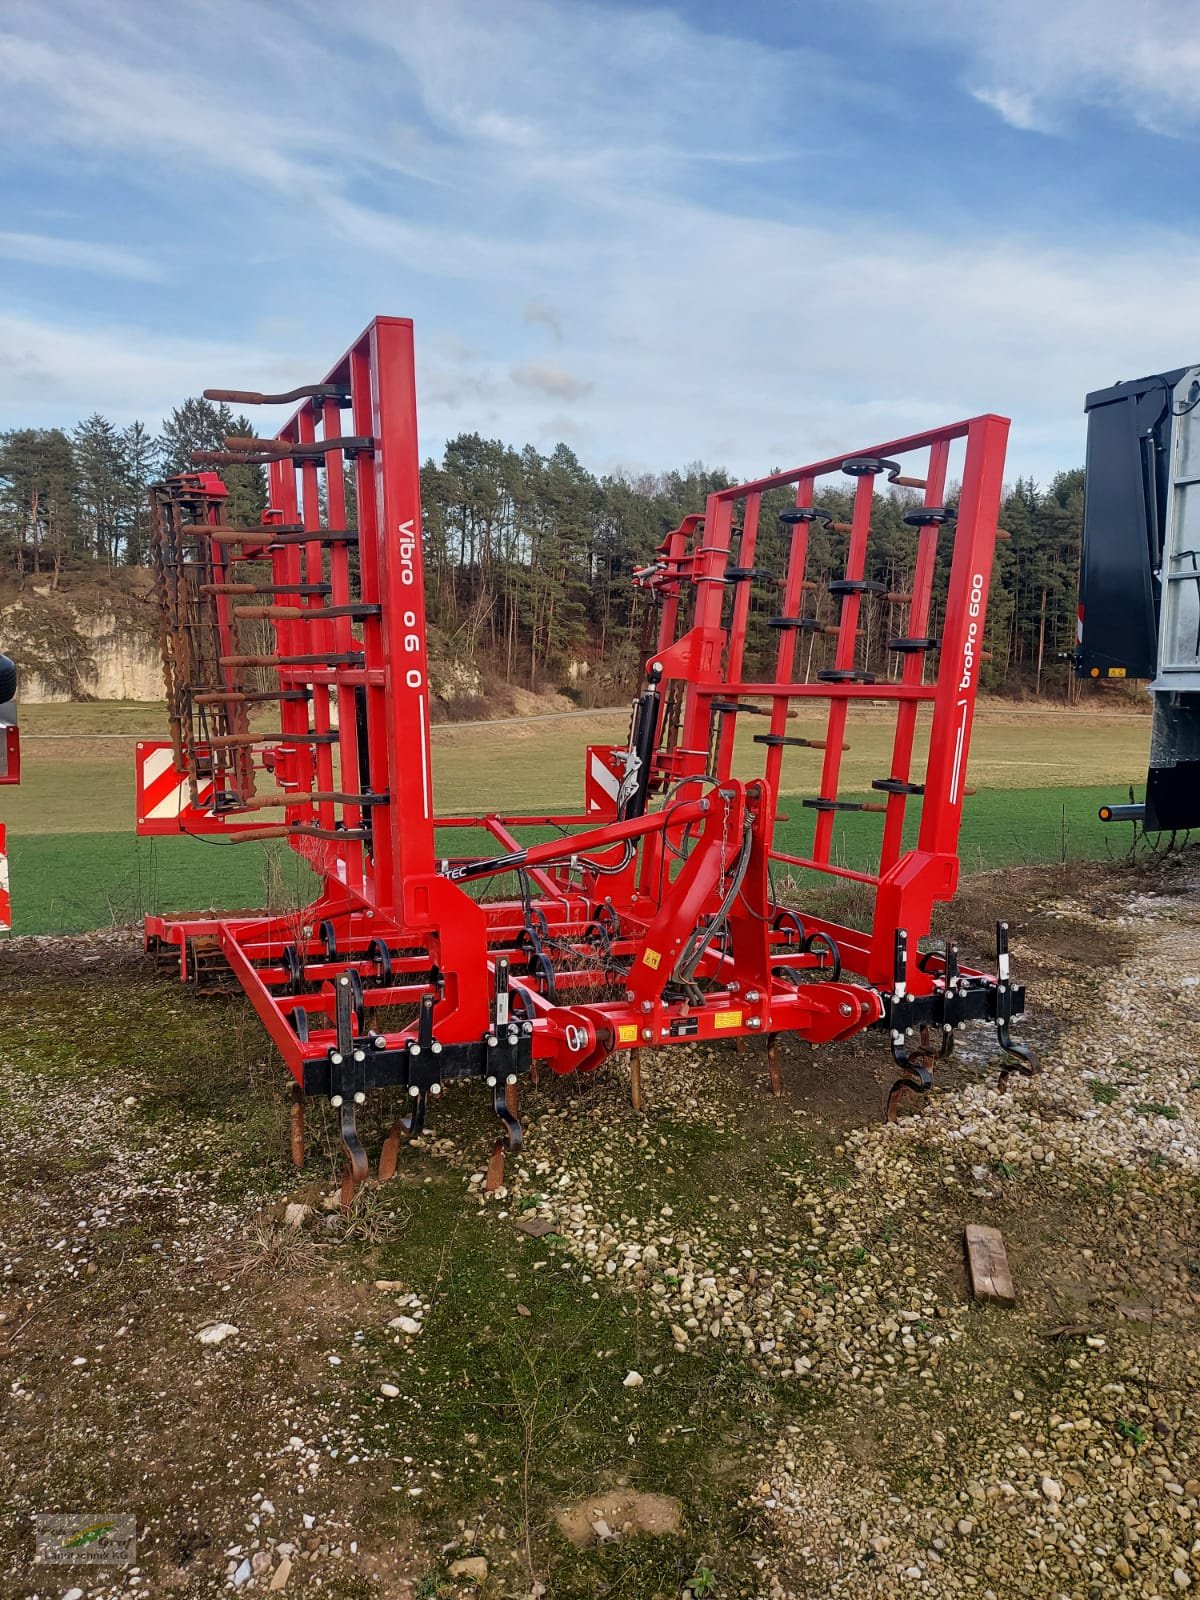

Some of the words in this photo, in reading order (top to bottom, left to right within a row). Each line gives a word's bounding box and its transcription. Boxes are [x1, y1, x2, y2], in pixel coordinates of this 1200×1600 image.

[398, 519, 416, 586] Vibro
[957, 622, 978, 706] broPro
[968, 573, 984, 618] 600
